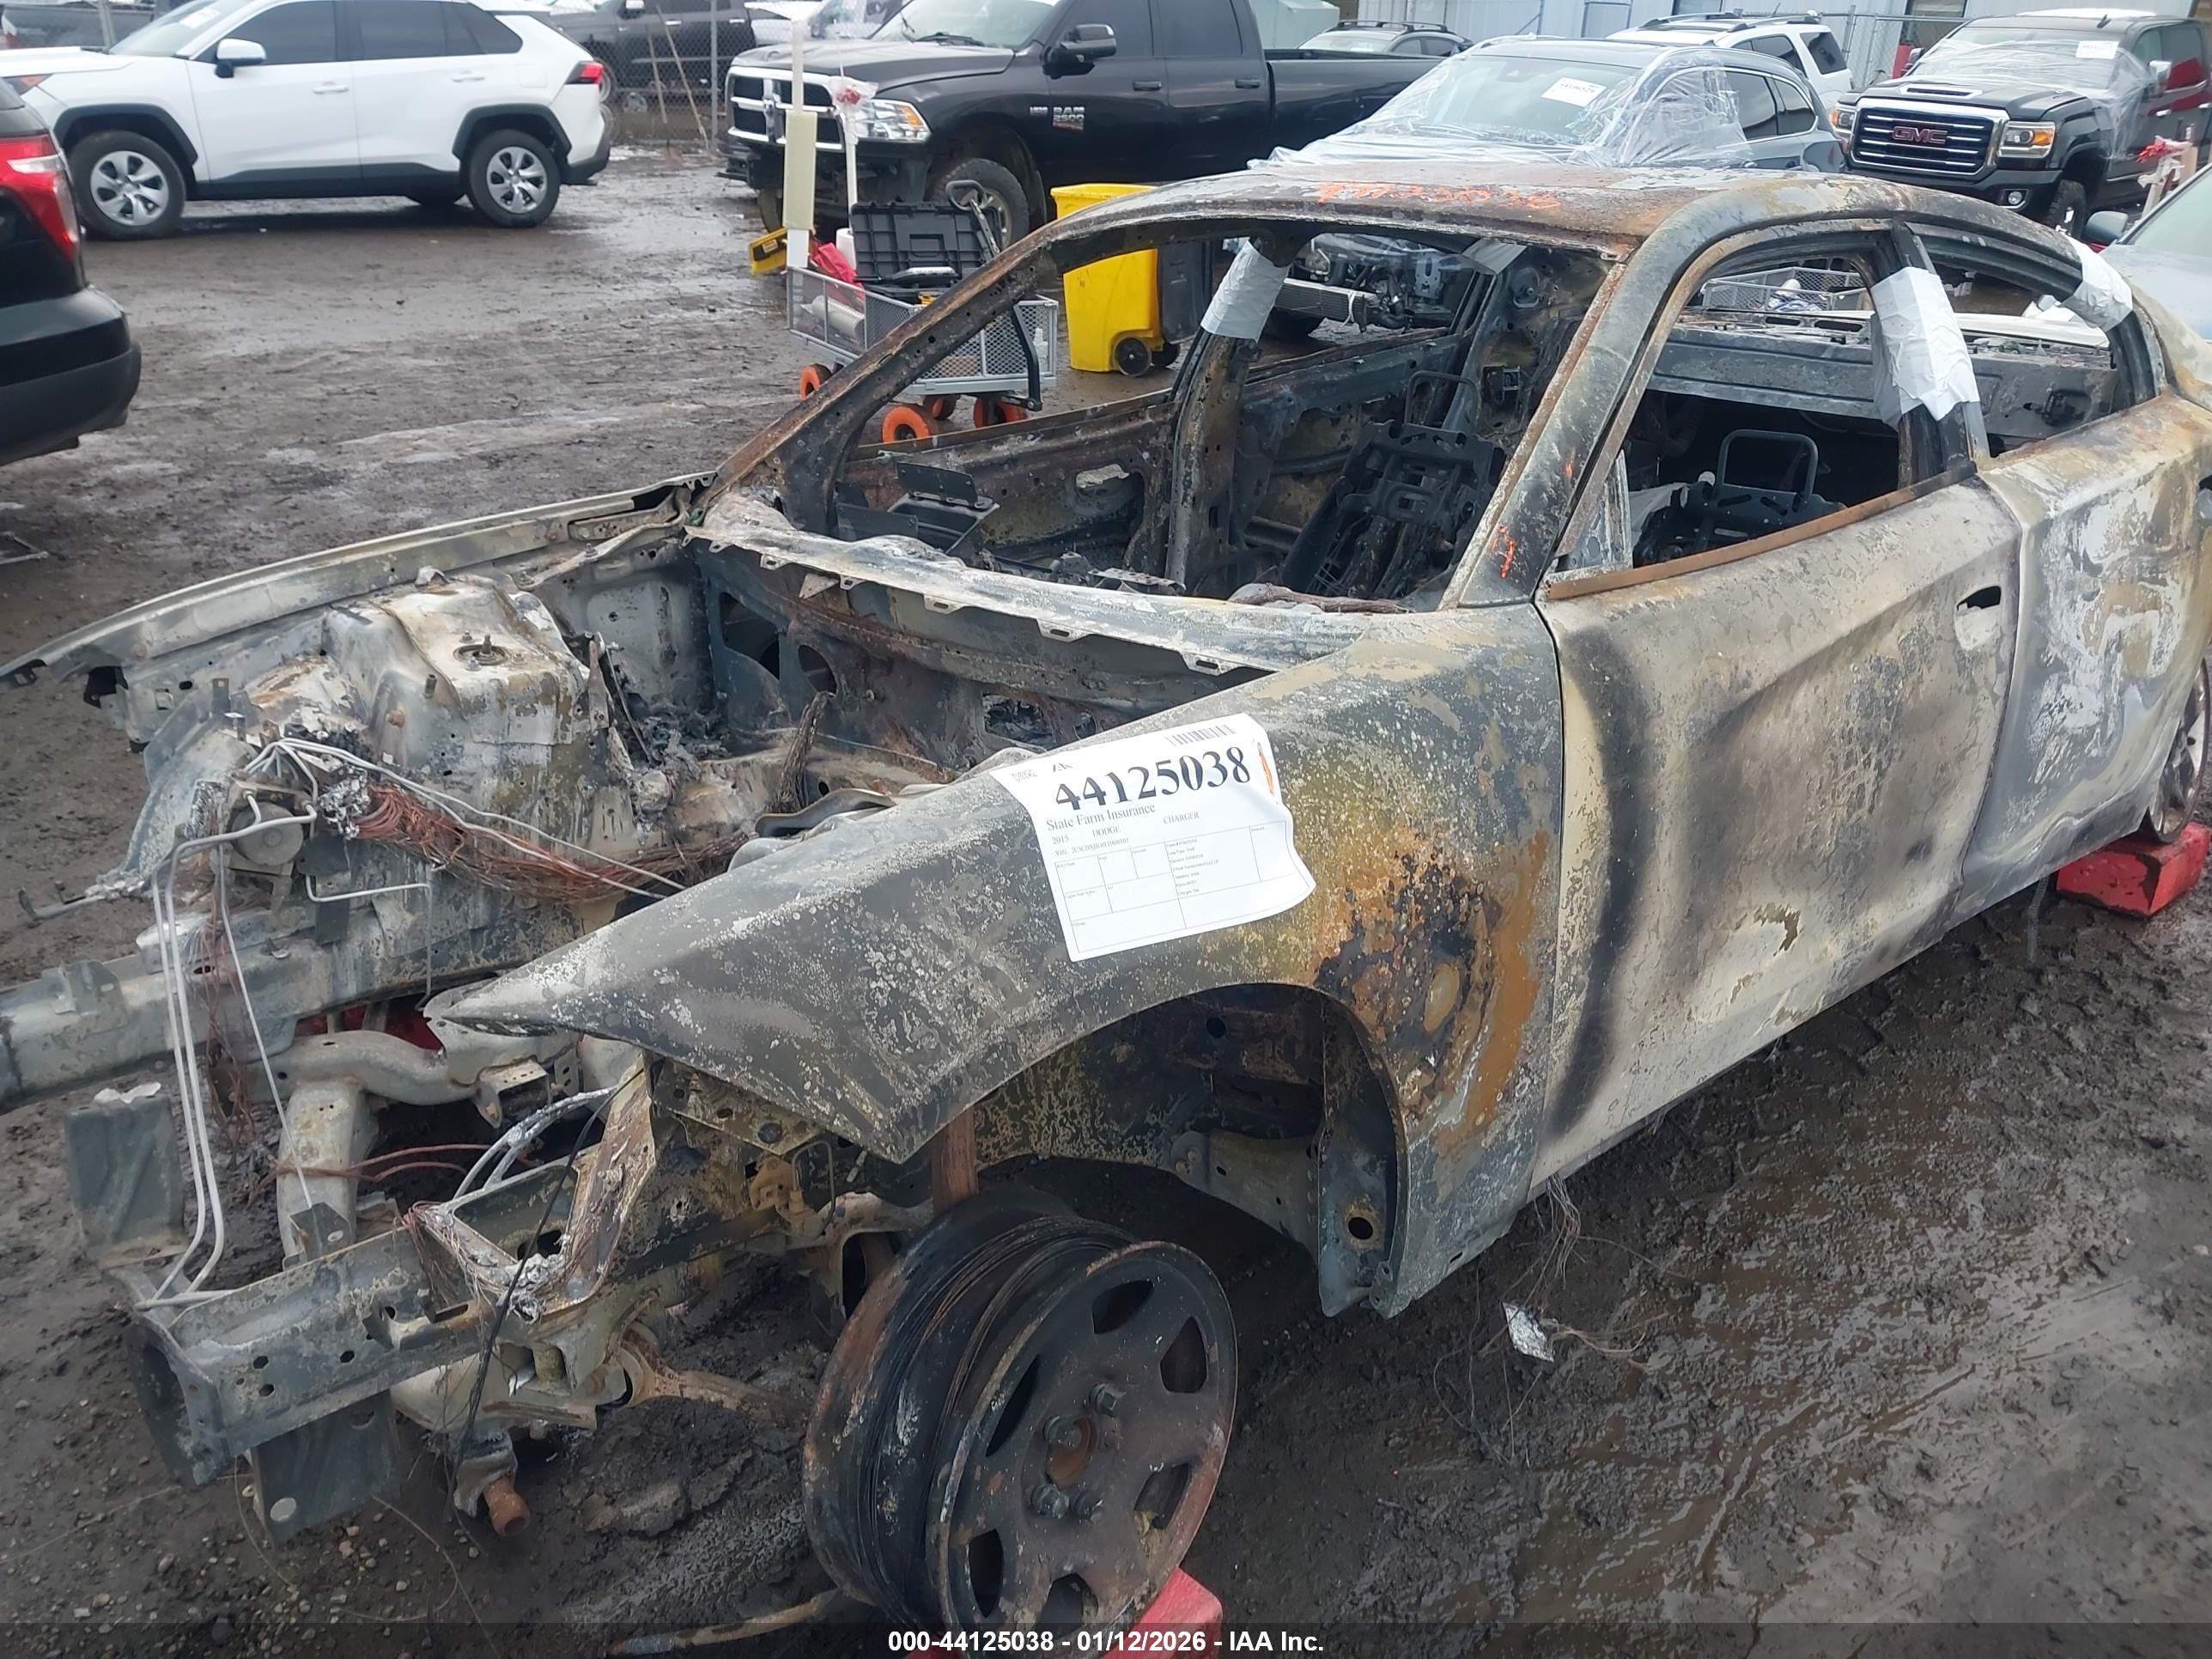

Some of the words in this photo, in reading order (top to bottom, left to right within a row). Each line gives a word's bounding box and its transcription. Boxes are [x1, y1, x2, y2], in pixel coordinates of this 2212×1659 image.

[1893, 126, 1948, 144] GMC
[1055, 746, 1251, 811] 44125038
[1046, 817, 1074, 831] State
[1076, 811, 1105, 825] Farm
[1107, 804, 1157, 821] Insurance
[1052, 836, 1070, 846] 2015
[1092, 825, 1121, 838] DODGE
[1163, 811, 1200, 824] CHARGER
